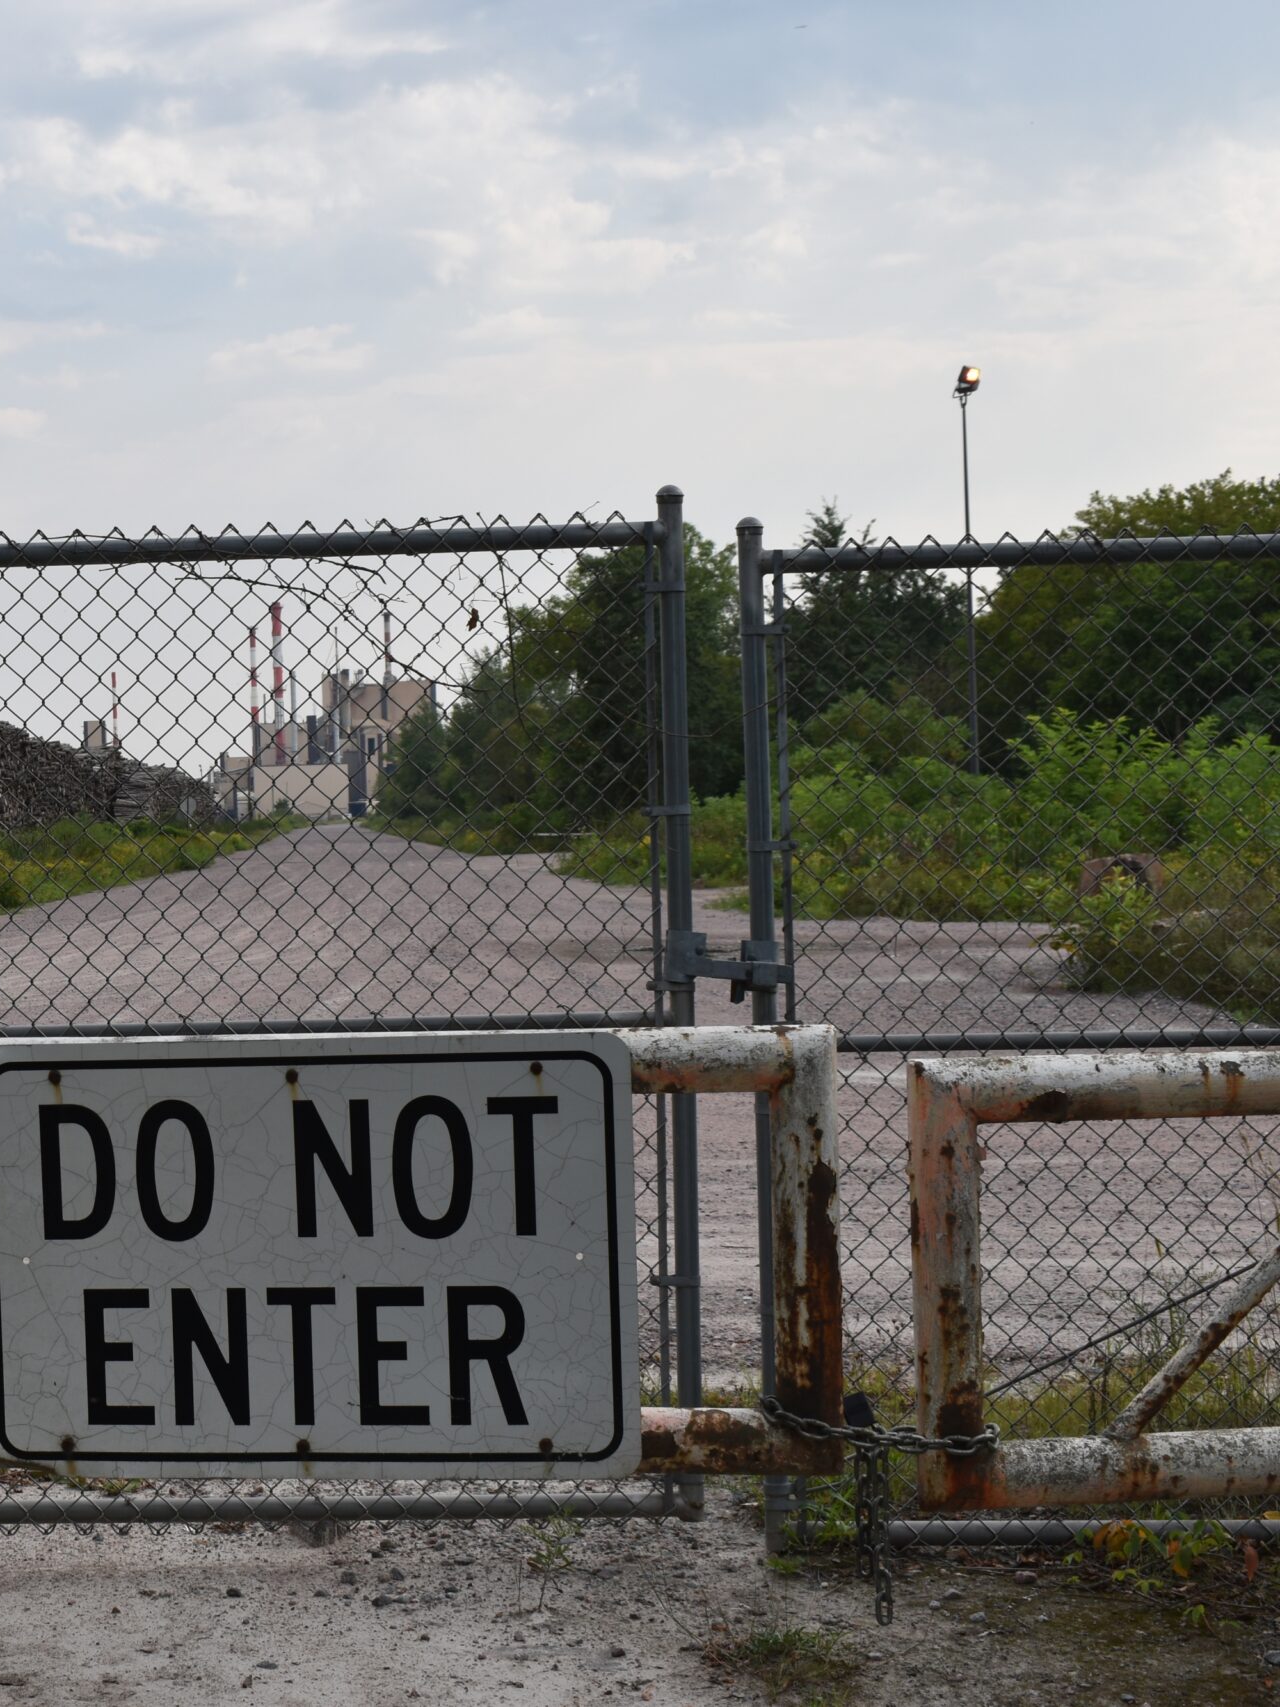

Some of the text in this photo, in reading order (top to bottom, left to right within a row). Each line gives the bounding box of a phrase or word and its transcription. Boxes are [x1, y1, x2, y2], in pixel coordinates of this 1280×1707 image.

[38, 1095, 559, 1242] DO NOT
[83, 1285, 529, 1426] ENTER
